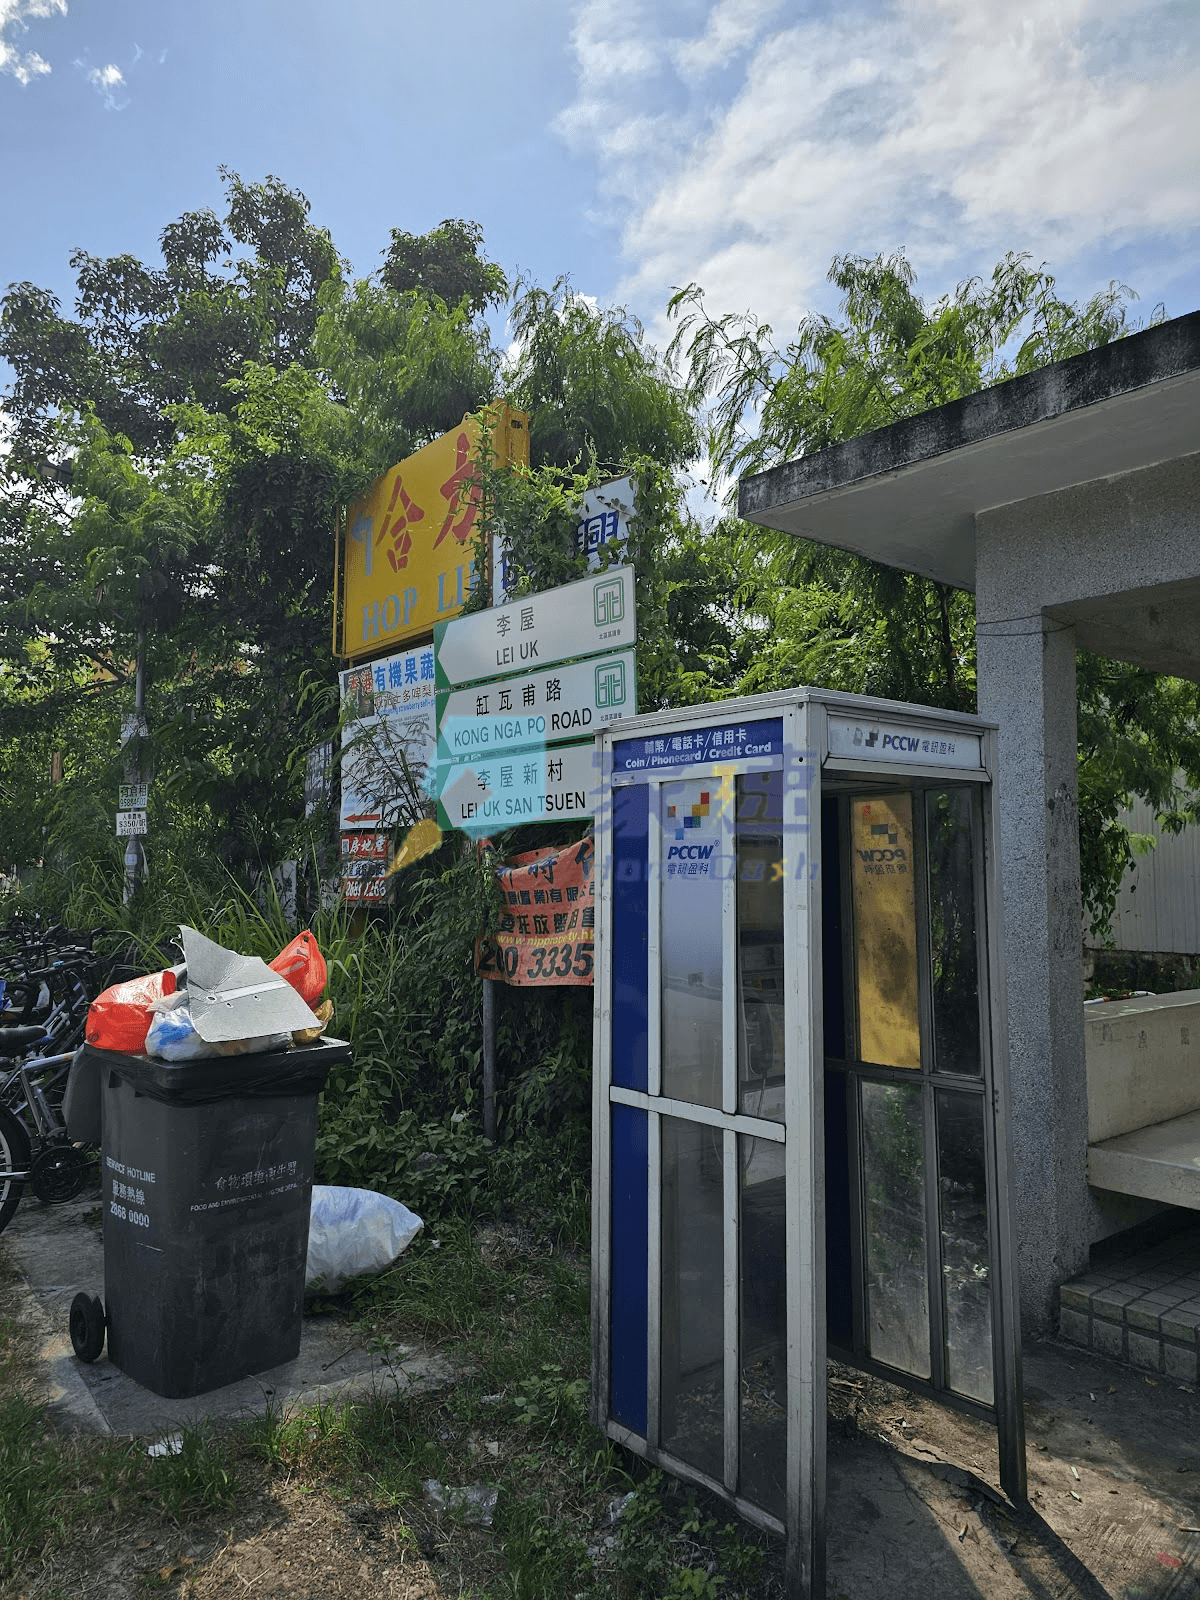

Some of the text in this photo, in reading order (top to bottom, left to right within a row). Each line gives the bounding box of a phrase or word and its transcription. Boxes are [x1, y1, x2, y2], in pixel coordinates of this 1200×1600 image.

[362, 586, 418, 642] HOP
[496, 606, 535, 637] 李屋
[496, 640, 539, 666] LEI UK
[374, 652, 434, 691] 有機果蔬
[476, 678, 561, 716] 缸瓦甫路
[454, 707, 592, 747] KONG NGA PO ROAD
[745, 742, 772, 755] Card
[882, 735, 920, 752] PCCW
[477, 758, 563, 790] 李屋新村
[461, 791, 586, 819] LEI UK SAN TSUEN
[667, 845, 714, 860] PCCW
[667, 862, 709, 875] 電訊盈科
[127, 1166, 156, 1183] HOTLINE
[110, 1200, 150, 1228] 2868 0000
